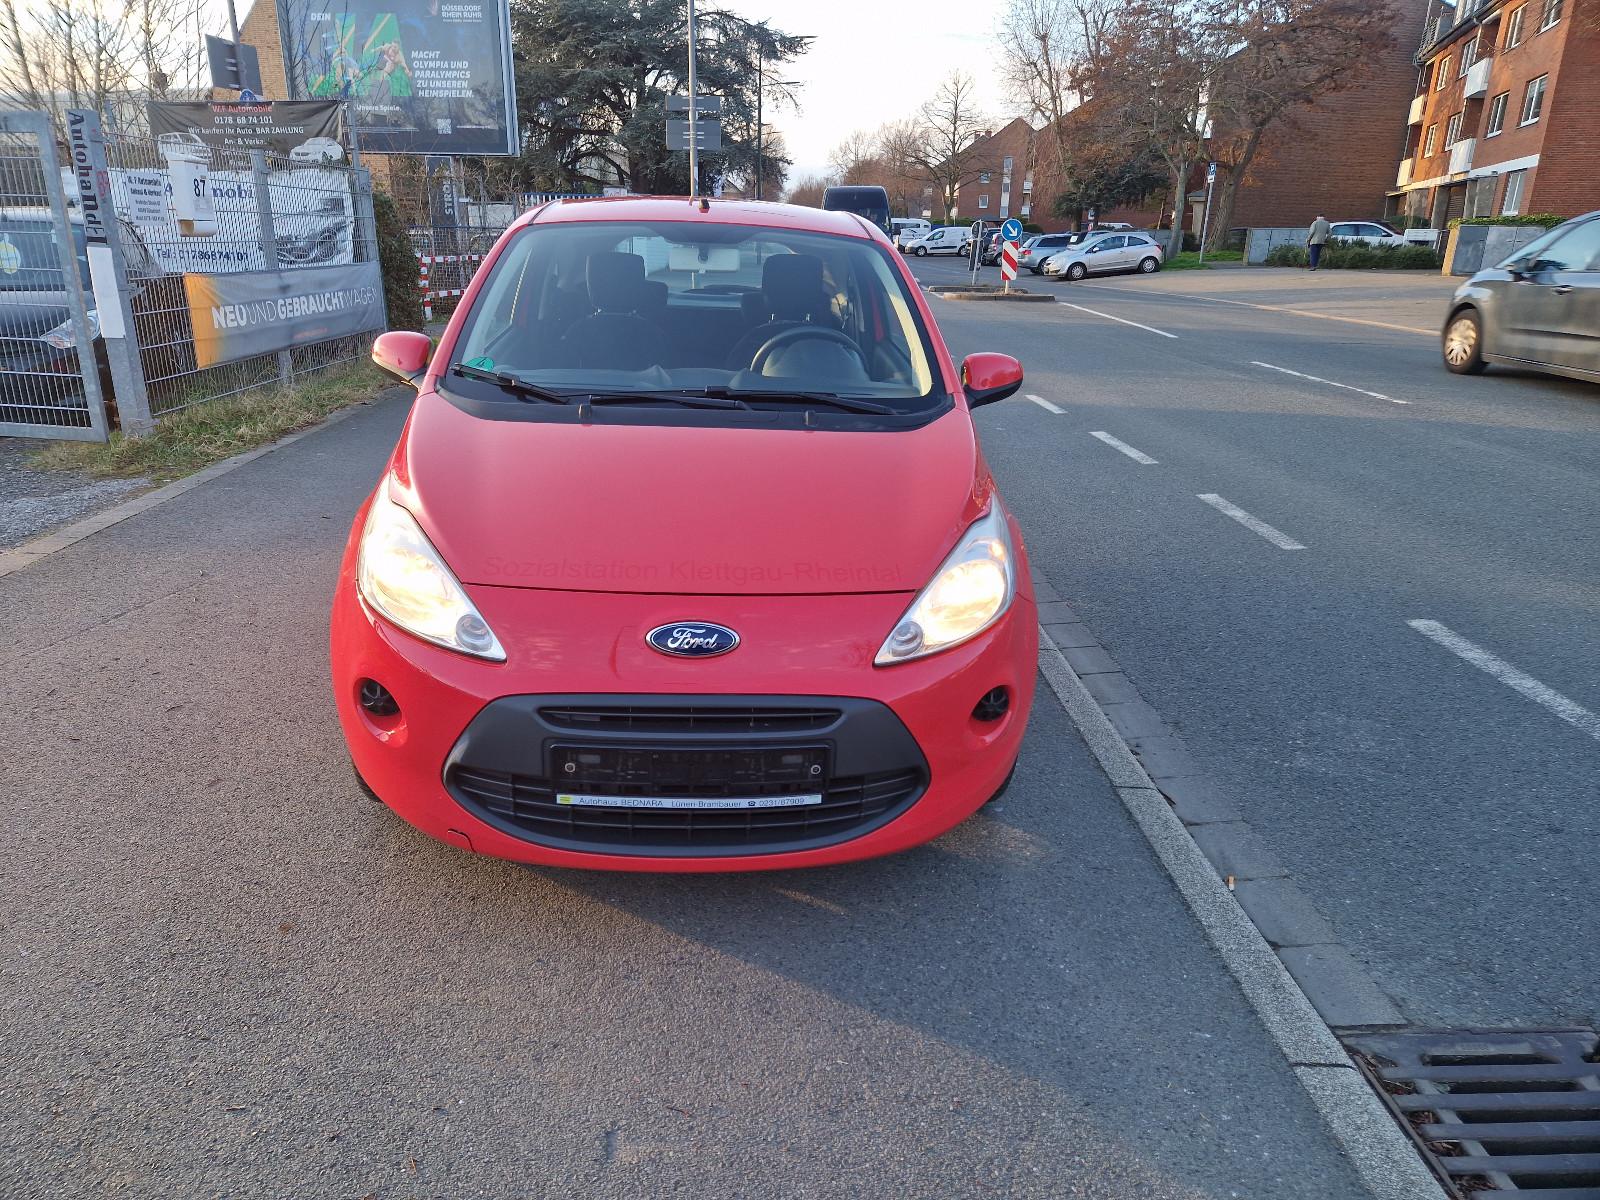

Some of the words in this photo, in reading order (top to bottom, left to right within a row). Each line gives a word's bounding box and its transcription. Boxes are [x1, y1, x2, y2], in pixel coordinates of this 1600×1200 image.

[441, 4, 482, 12] DÜSSELDORF
[310, 12, 331, 21] DEIN
[411, 50, 440, 59] MACHT
[413, 60, 449, 69] OLYMPIA
[450, 60, 469, 69] UND
[414, 70, 471, 79] PARALYMPICS
[416, 79, 428, 88] ZU
[429, 79, 468, 89] UNSEREN
[418, 89, 475, 98] HEIMSPIELEN.
[228, 104, 273, 113] Automobile
[214, 116, 233, 125] 0178
[236, 116, 247, 125] 68
[248, 116, 257, 125] 74
[259, 116, 273, 125] 101
[188, 127, 200, 135] Wir
[201, 127, 224, 136] kaufen
[255, 127, 270, 135] BAR
[271, 127, 304, 135] ZAHLUNG
[68, 110, 108, 245] Autohandel
[193, 178, 206, 198] 87
[482, 556, 658, 580] Sozialstation
[669, 559, 904, 585] Klettgau-Rheintal
[667, 627, 719, 649] Ford
[578, 797, 618, 806] Autohaus
[621, 799, 664, 807] BEDNARA
